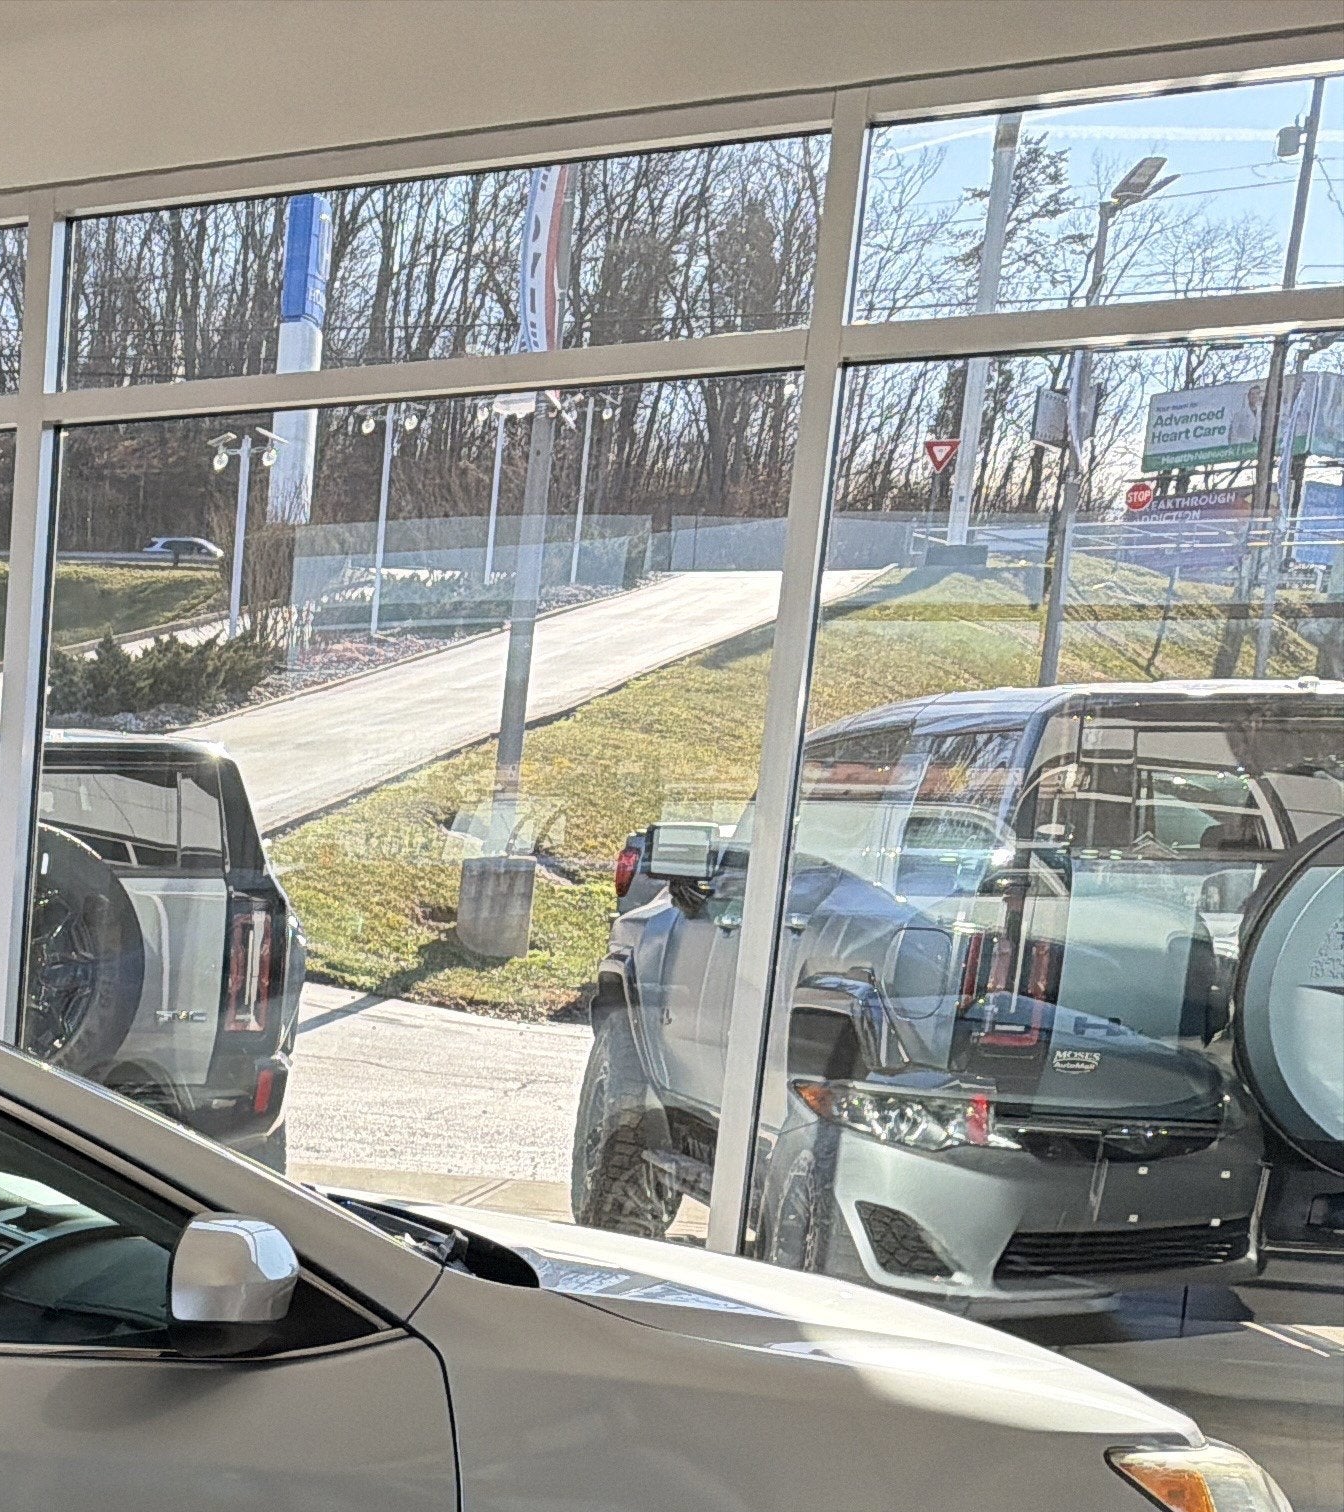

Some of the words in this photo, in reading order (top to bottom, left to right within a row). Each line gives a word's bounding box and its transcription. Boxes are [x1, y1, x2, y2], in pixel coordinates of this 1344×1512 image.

[1153, 406, 1225, 428] Advanced
[1151, 428, 1191, 444] Heart
[1193, 425, 1227, 438] Care
[1127, 490, 1151, 503] STOP
[1145, 491, 1236, 511] EAKTHROUGH
[1053, 1050, 1101, 1061] MOSES
